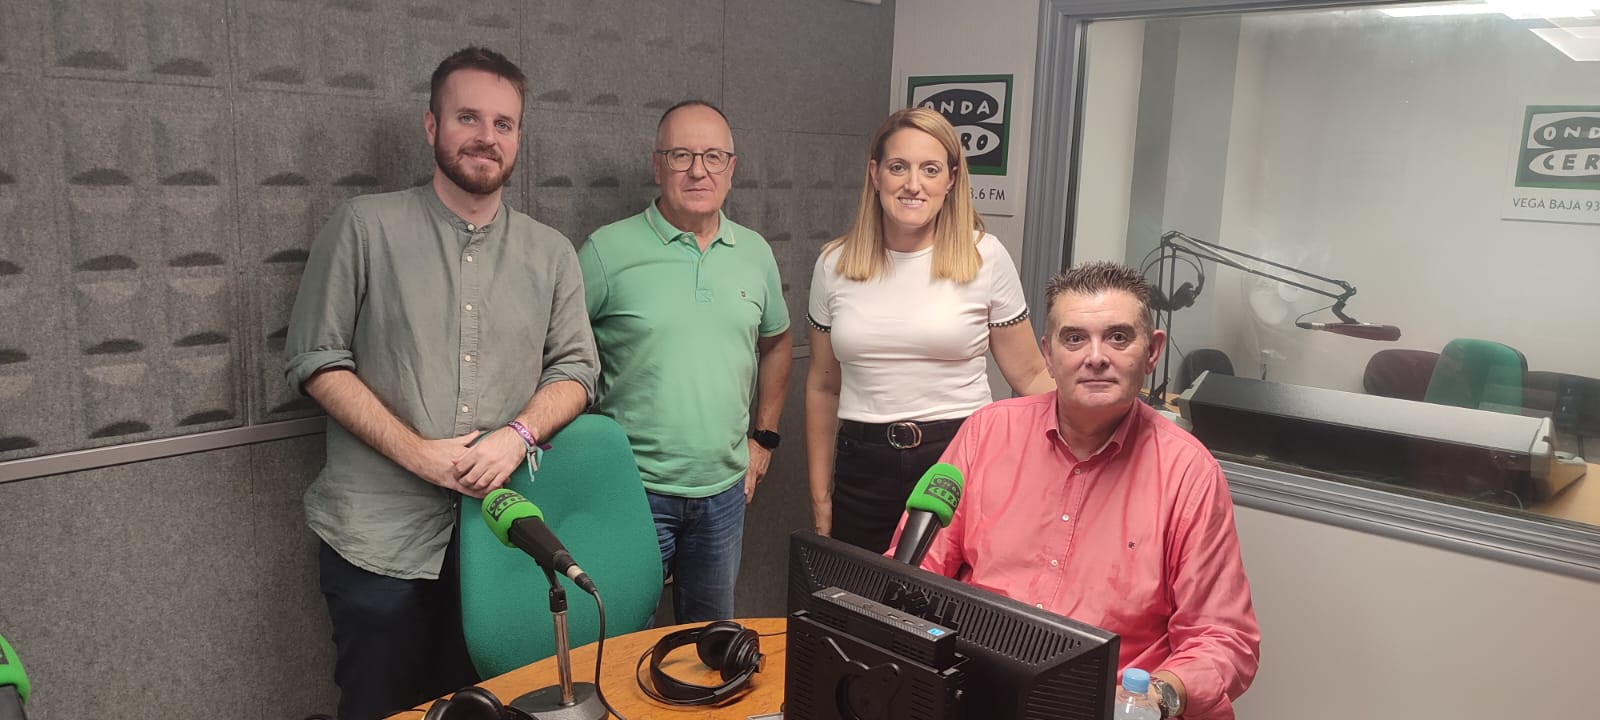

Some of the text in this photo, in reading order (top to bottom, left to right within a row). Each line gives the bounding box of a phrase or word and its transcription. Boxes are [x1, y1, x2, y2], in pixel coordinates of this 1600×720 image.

[924, 100, 990, 115] ONDA
[960, 132, 989, 151] RO
[969, 187, 1006, 200] 3.6 FM
[1513, 197, 1546, 209] VEGA
[1549, 199, 1582, 211] BAJA
